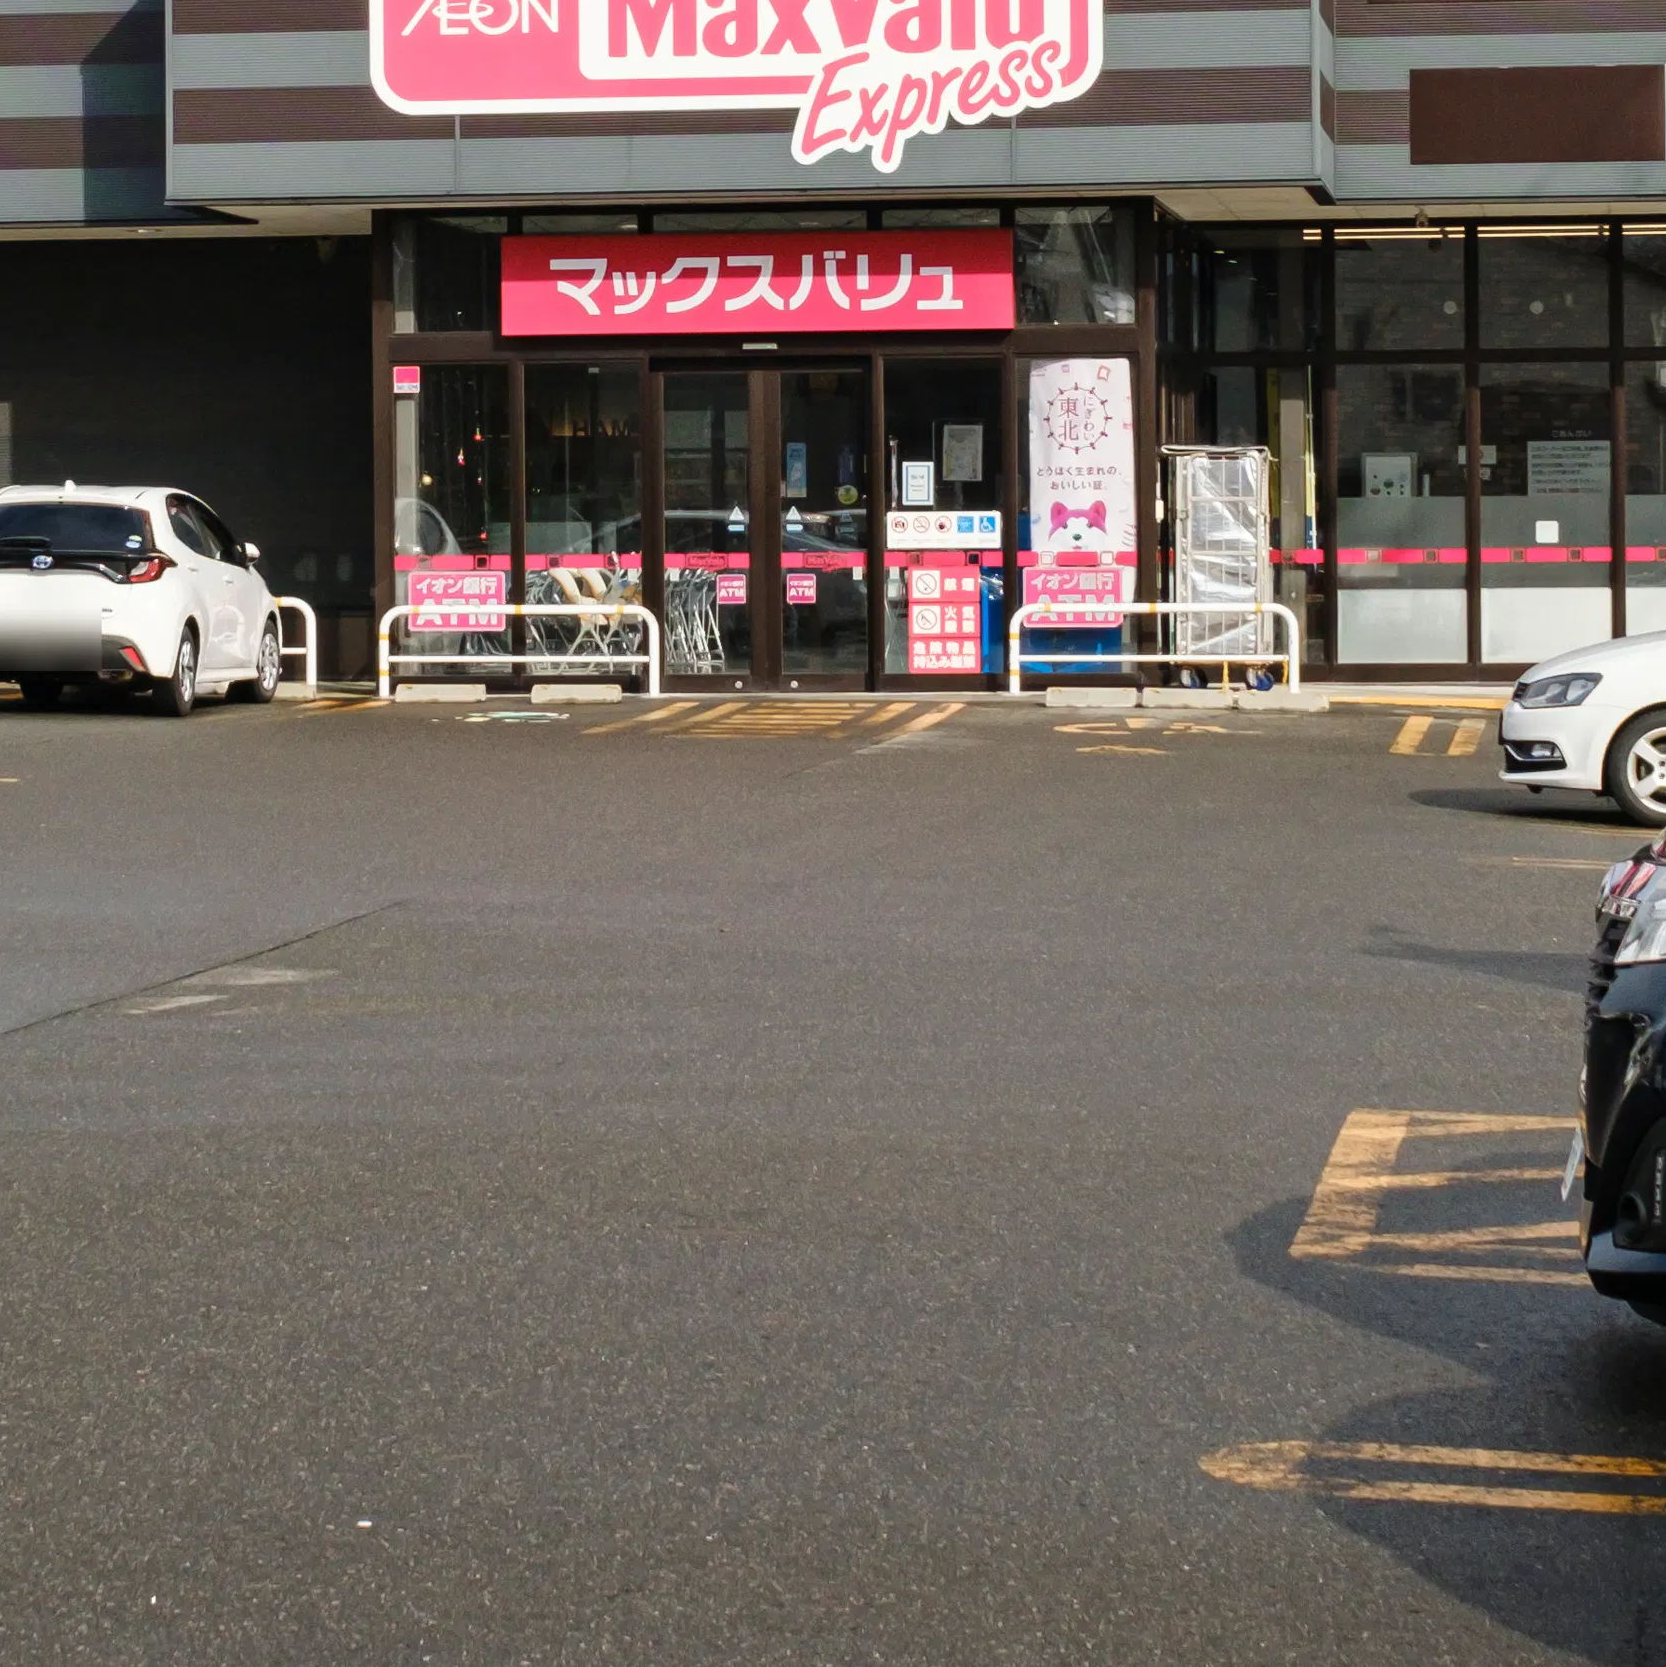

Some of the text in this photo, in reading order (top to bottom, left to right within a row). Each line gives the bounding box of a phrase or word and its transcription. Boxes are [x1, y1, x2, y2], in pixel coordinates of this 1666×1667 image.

[800, 39, 1062, 164] Express
[549, 250, 964, 316] マックスバリュ
[1058, 397, 1079, 441] 東北
[416, 576, 498, 595] イオン銀行
[720, 588, 744, 598] ATM
[789, 587, 814, 597] ATM
[1031, 572, 1116, 591] イオン銀行
[416, 598, 499, 627] ATM
[1031, 594, 1116, 622] ATM
